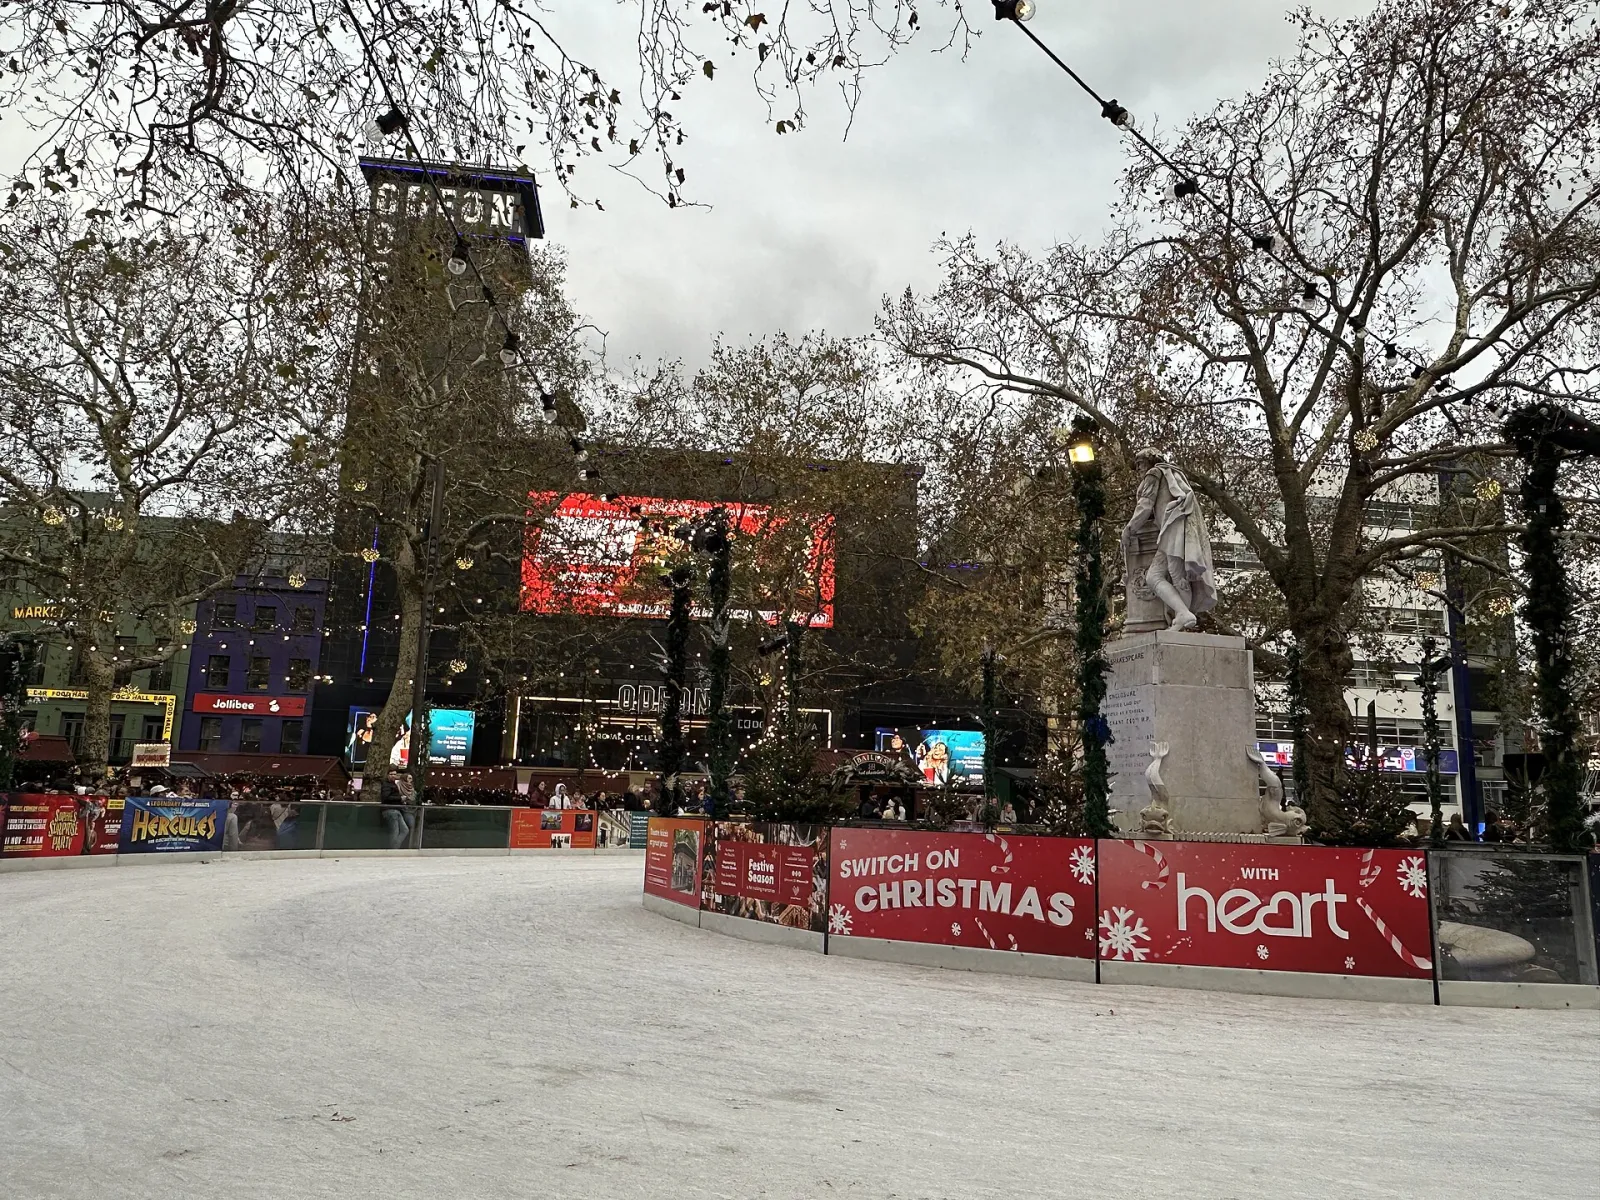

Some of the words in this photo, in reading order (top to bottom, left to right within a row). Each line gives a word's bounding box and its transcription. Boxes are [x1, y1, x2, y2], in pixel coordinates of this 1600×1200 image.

[212, 699, 255, 710] Jollibee
[131, 808, 217, 842] HERCULES
[10, 836, 22, 845] NOV
[32, 836, 44, 844] JAN
[52, 835, 73, 851] PARTY
[748, 858, 775, 873] Festive
[840, 852, 919, 879] SWITCH
[926, 848, 960, 871] ON
[747, 870, 775, 885] Season
[1240, 867, 1279, 881] WITH
[854, 878, 1076, 927] CHRISTMAS
[1176, 872, 1350, 940] heart
